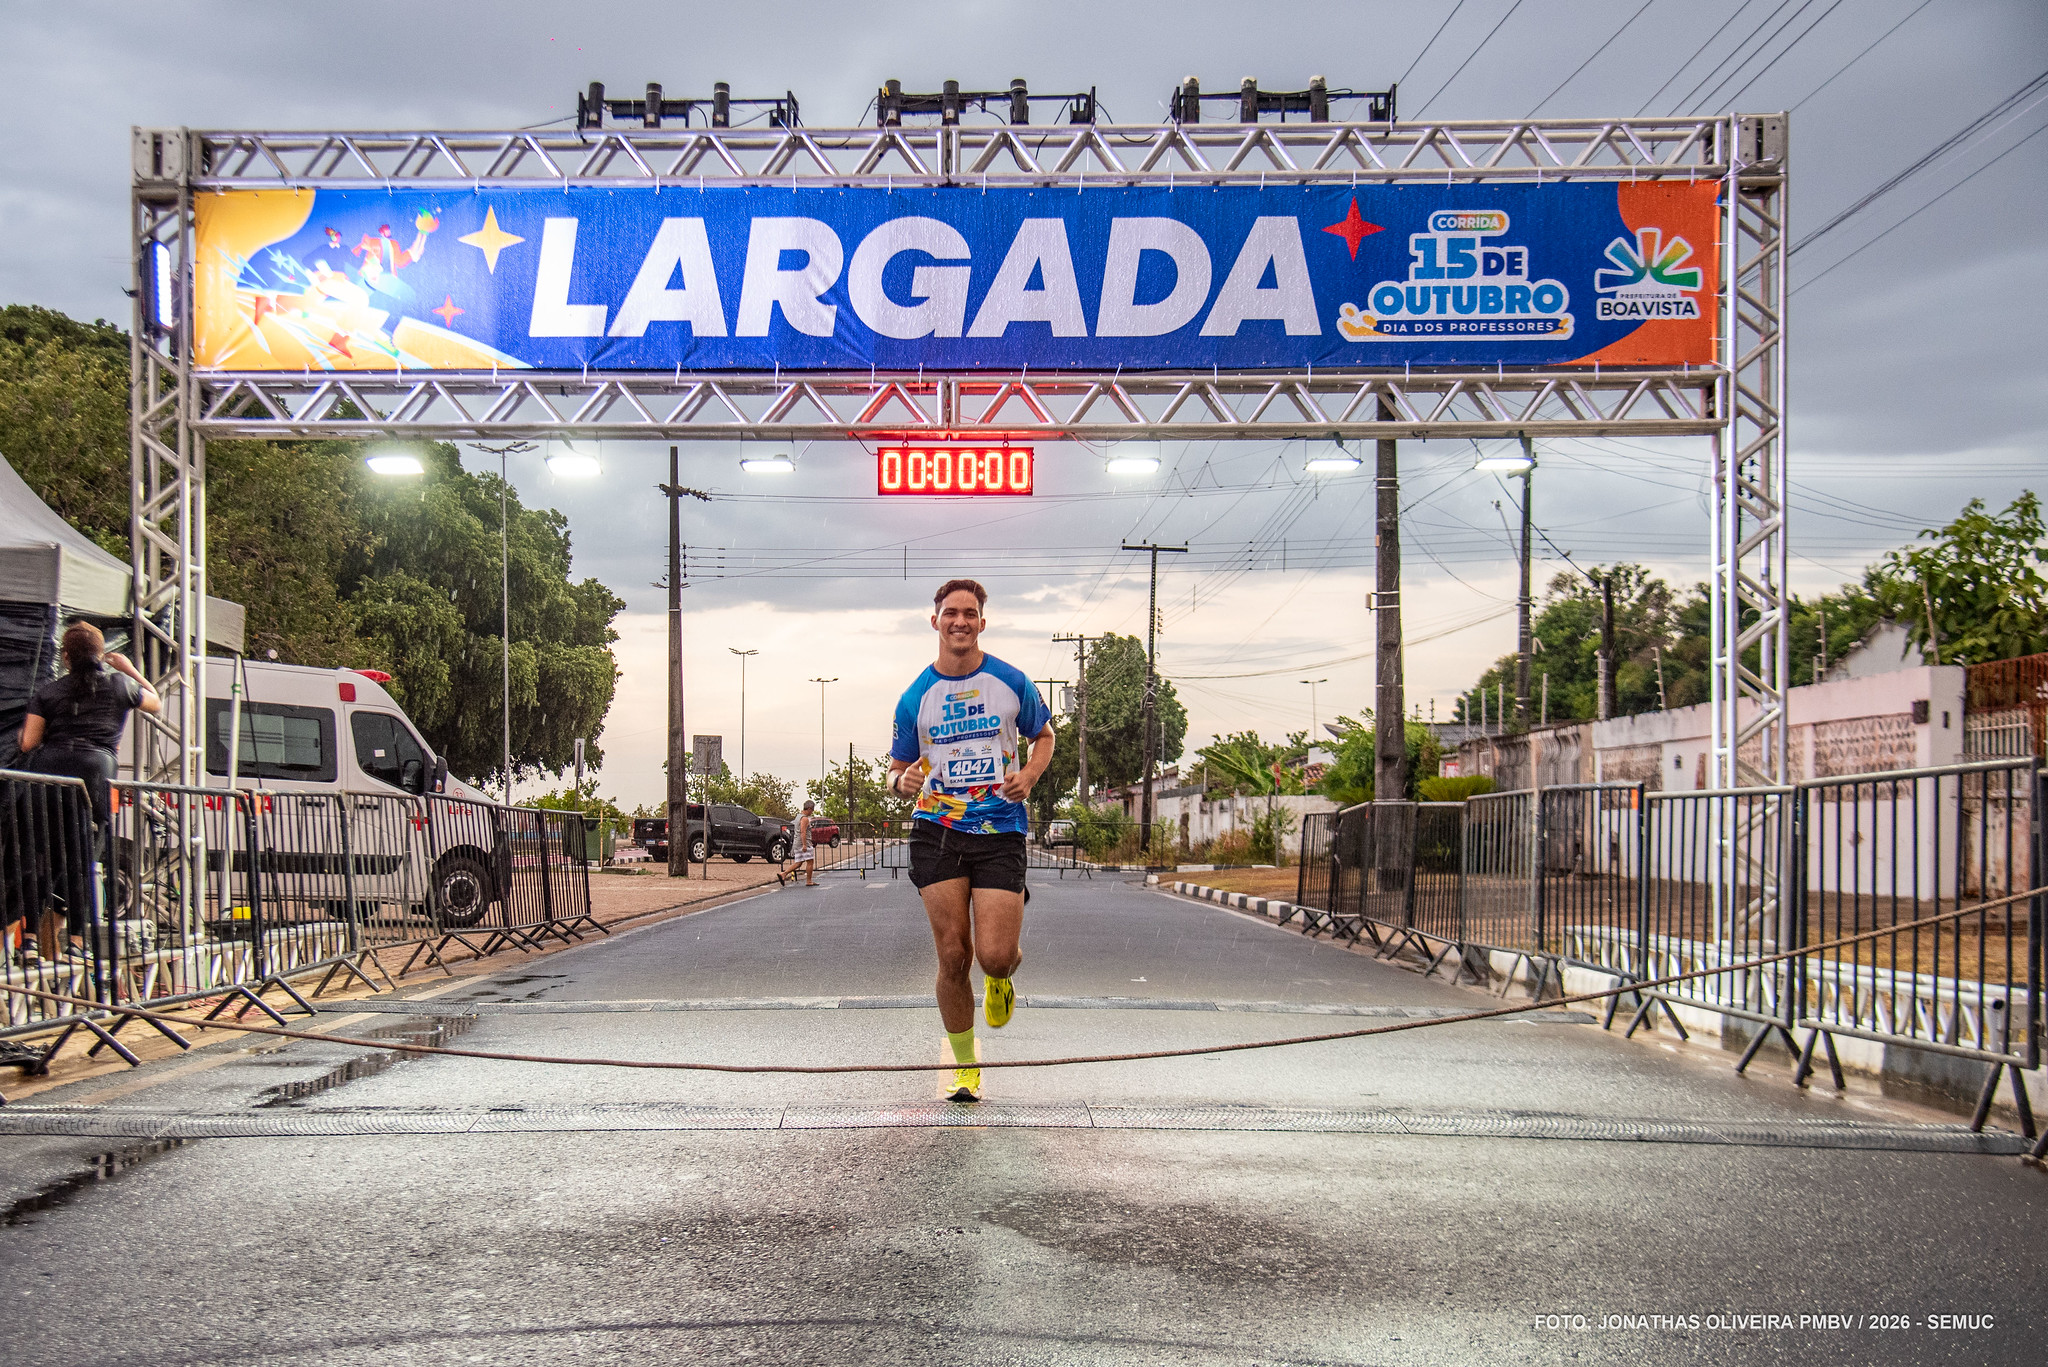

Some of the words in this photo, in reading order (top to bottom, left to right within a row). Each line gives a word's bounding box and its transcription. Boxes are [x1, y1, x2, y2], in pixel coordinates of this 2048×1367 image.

[1437, 216, 1501, 229] CORRIDA
[1414, 237, 1478, 280] 15
[1482, 251, 1523, 277] DE
[529, 216, 1321, 338] LARGADA
[1373, 284, 1564, 316] OUTUBRO
[1383, 323, 1408, 333] DIA
[1414, 323, 1444, 332] DOS
[1450, 322, 1554, 332] PROFESSORES
[883, 452, 1029, 489] 00:00:00
[942, 702, 967, 722] 15
[968, 703, 985, 716] DE
[929, 715, 1001, 737] OUTUBRO
[956, 729, 999, 741] PROFESSORES
[951, 759, 991, 775] 4047
